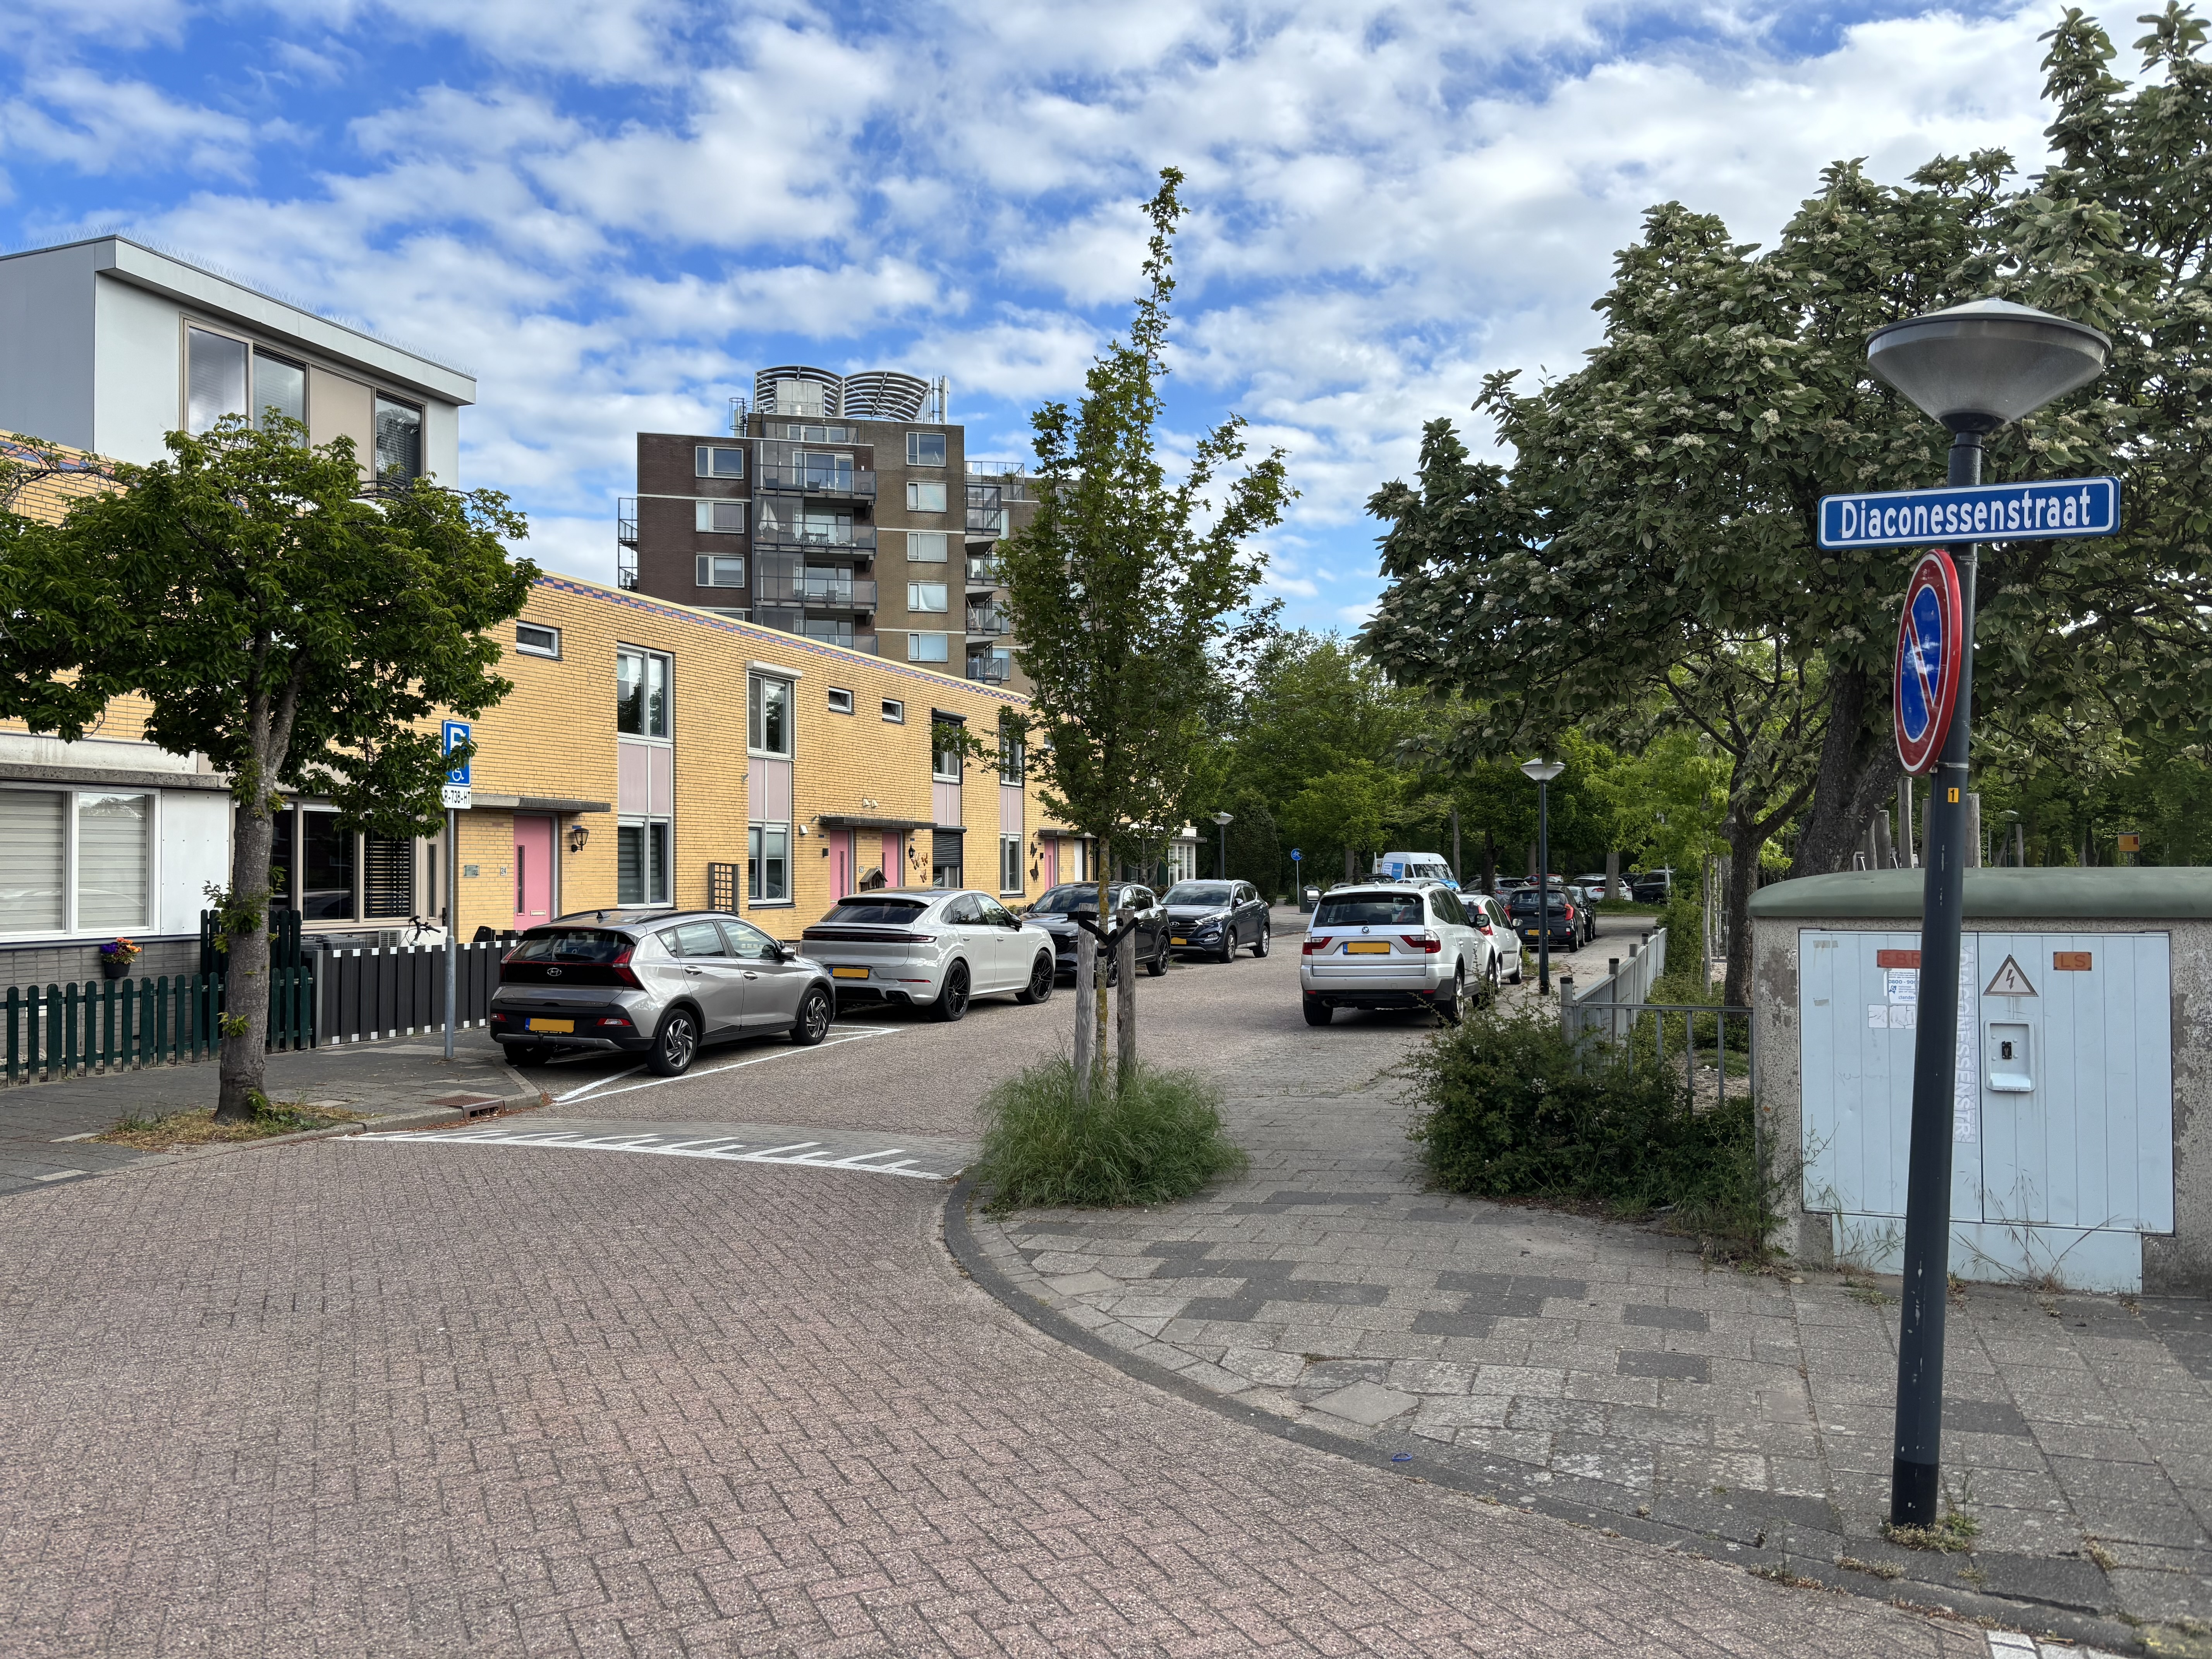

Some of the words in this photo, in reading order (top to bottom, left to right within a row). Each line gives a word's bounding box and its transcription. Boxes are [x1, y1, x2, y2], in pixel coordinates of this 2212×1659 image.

[1842, 486, 2090, 539] Diaconessenstraat
[1950, 788, 1955, 802] 1
[2061, 954, 2086, 967] LS
